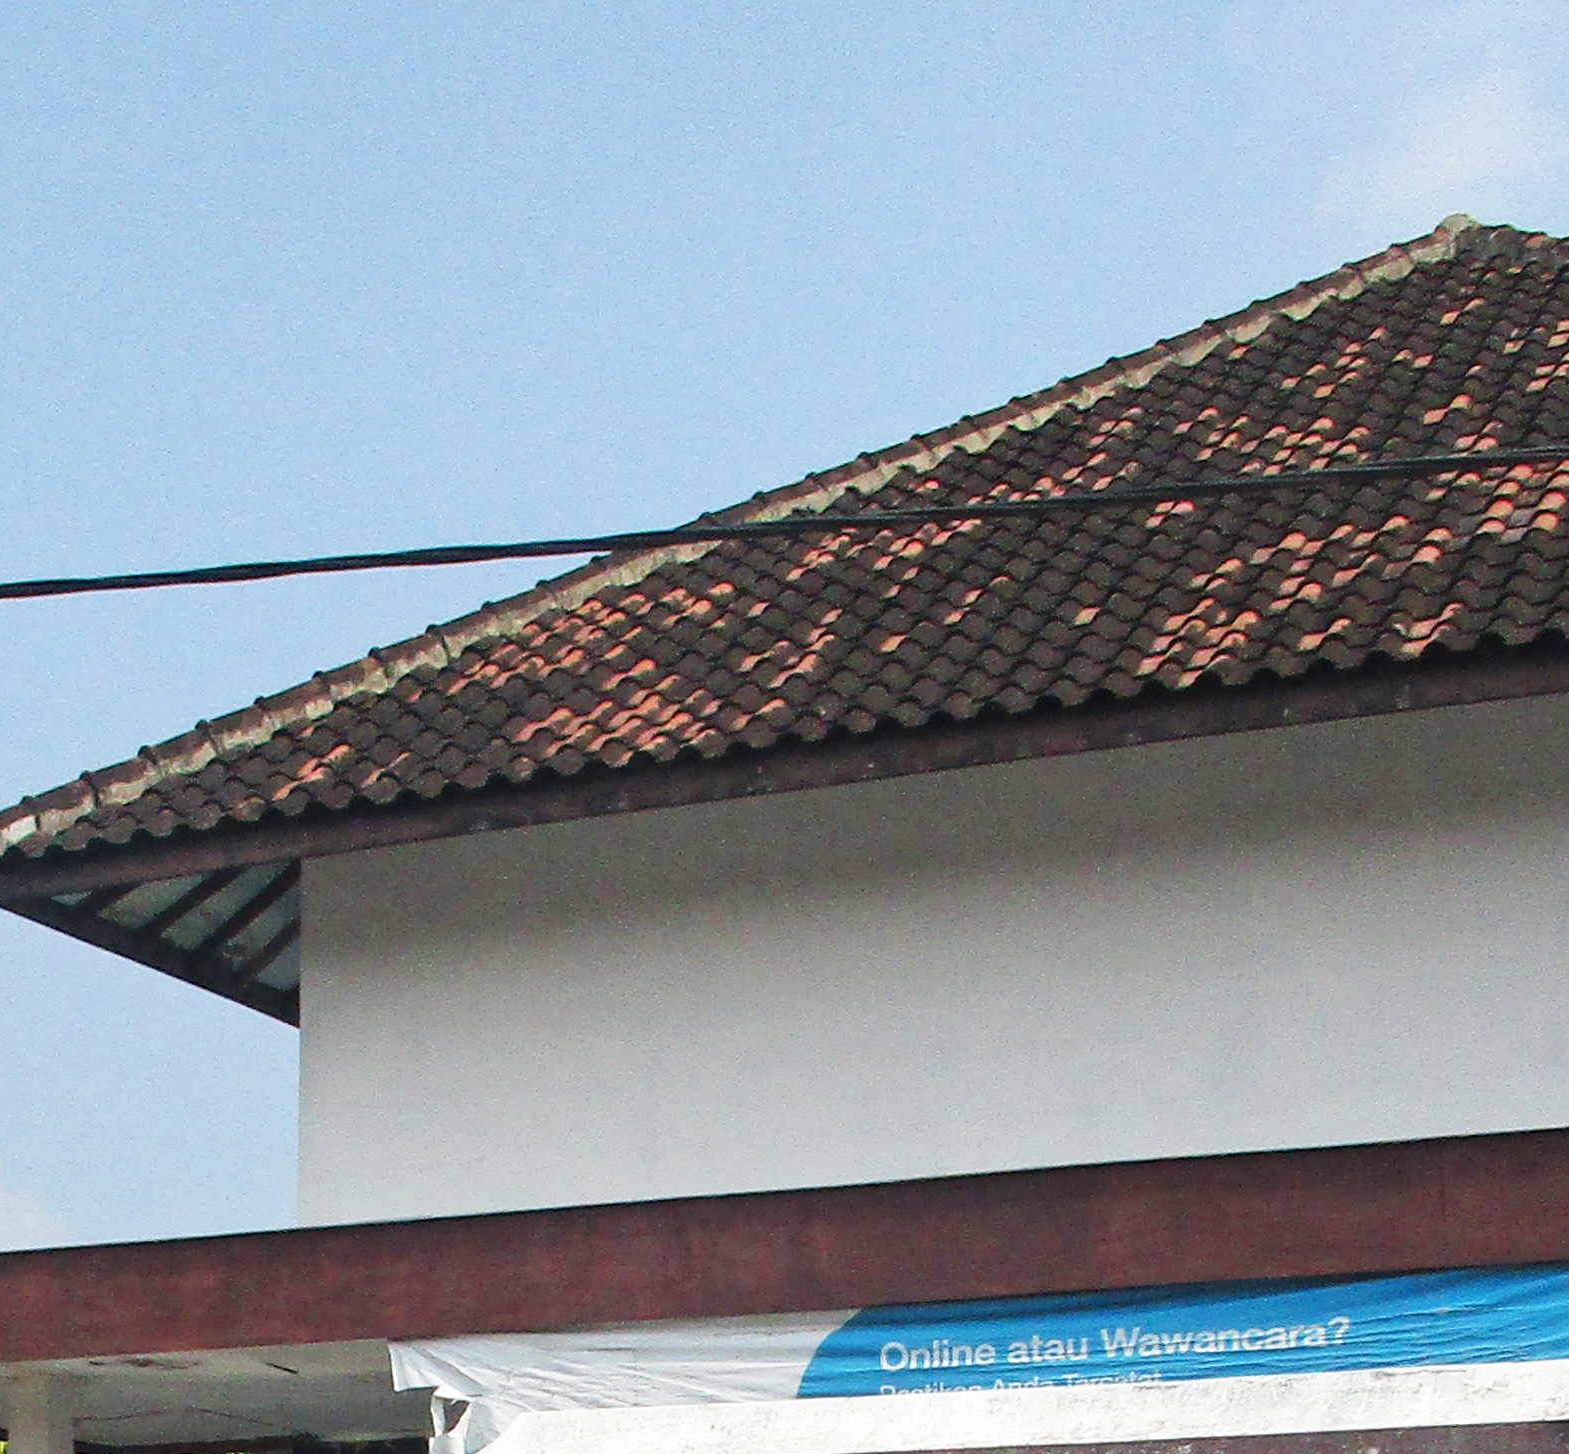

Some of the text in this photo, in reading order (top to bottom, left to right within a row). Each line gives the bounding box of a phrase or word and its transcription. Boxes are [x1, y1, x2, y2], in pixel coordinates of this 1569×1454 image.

[880, 1316, 1351, 1371] Online atau Wawancara?
